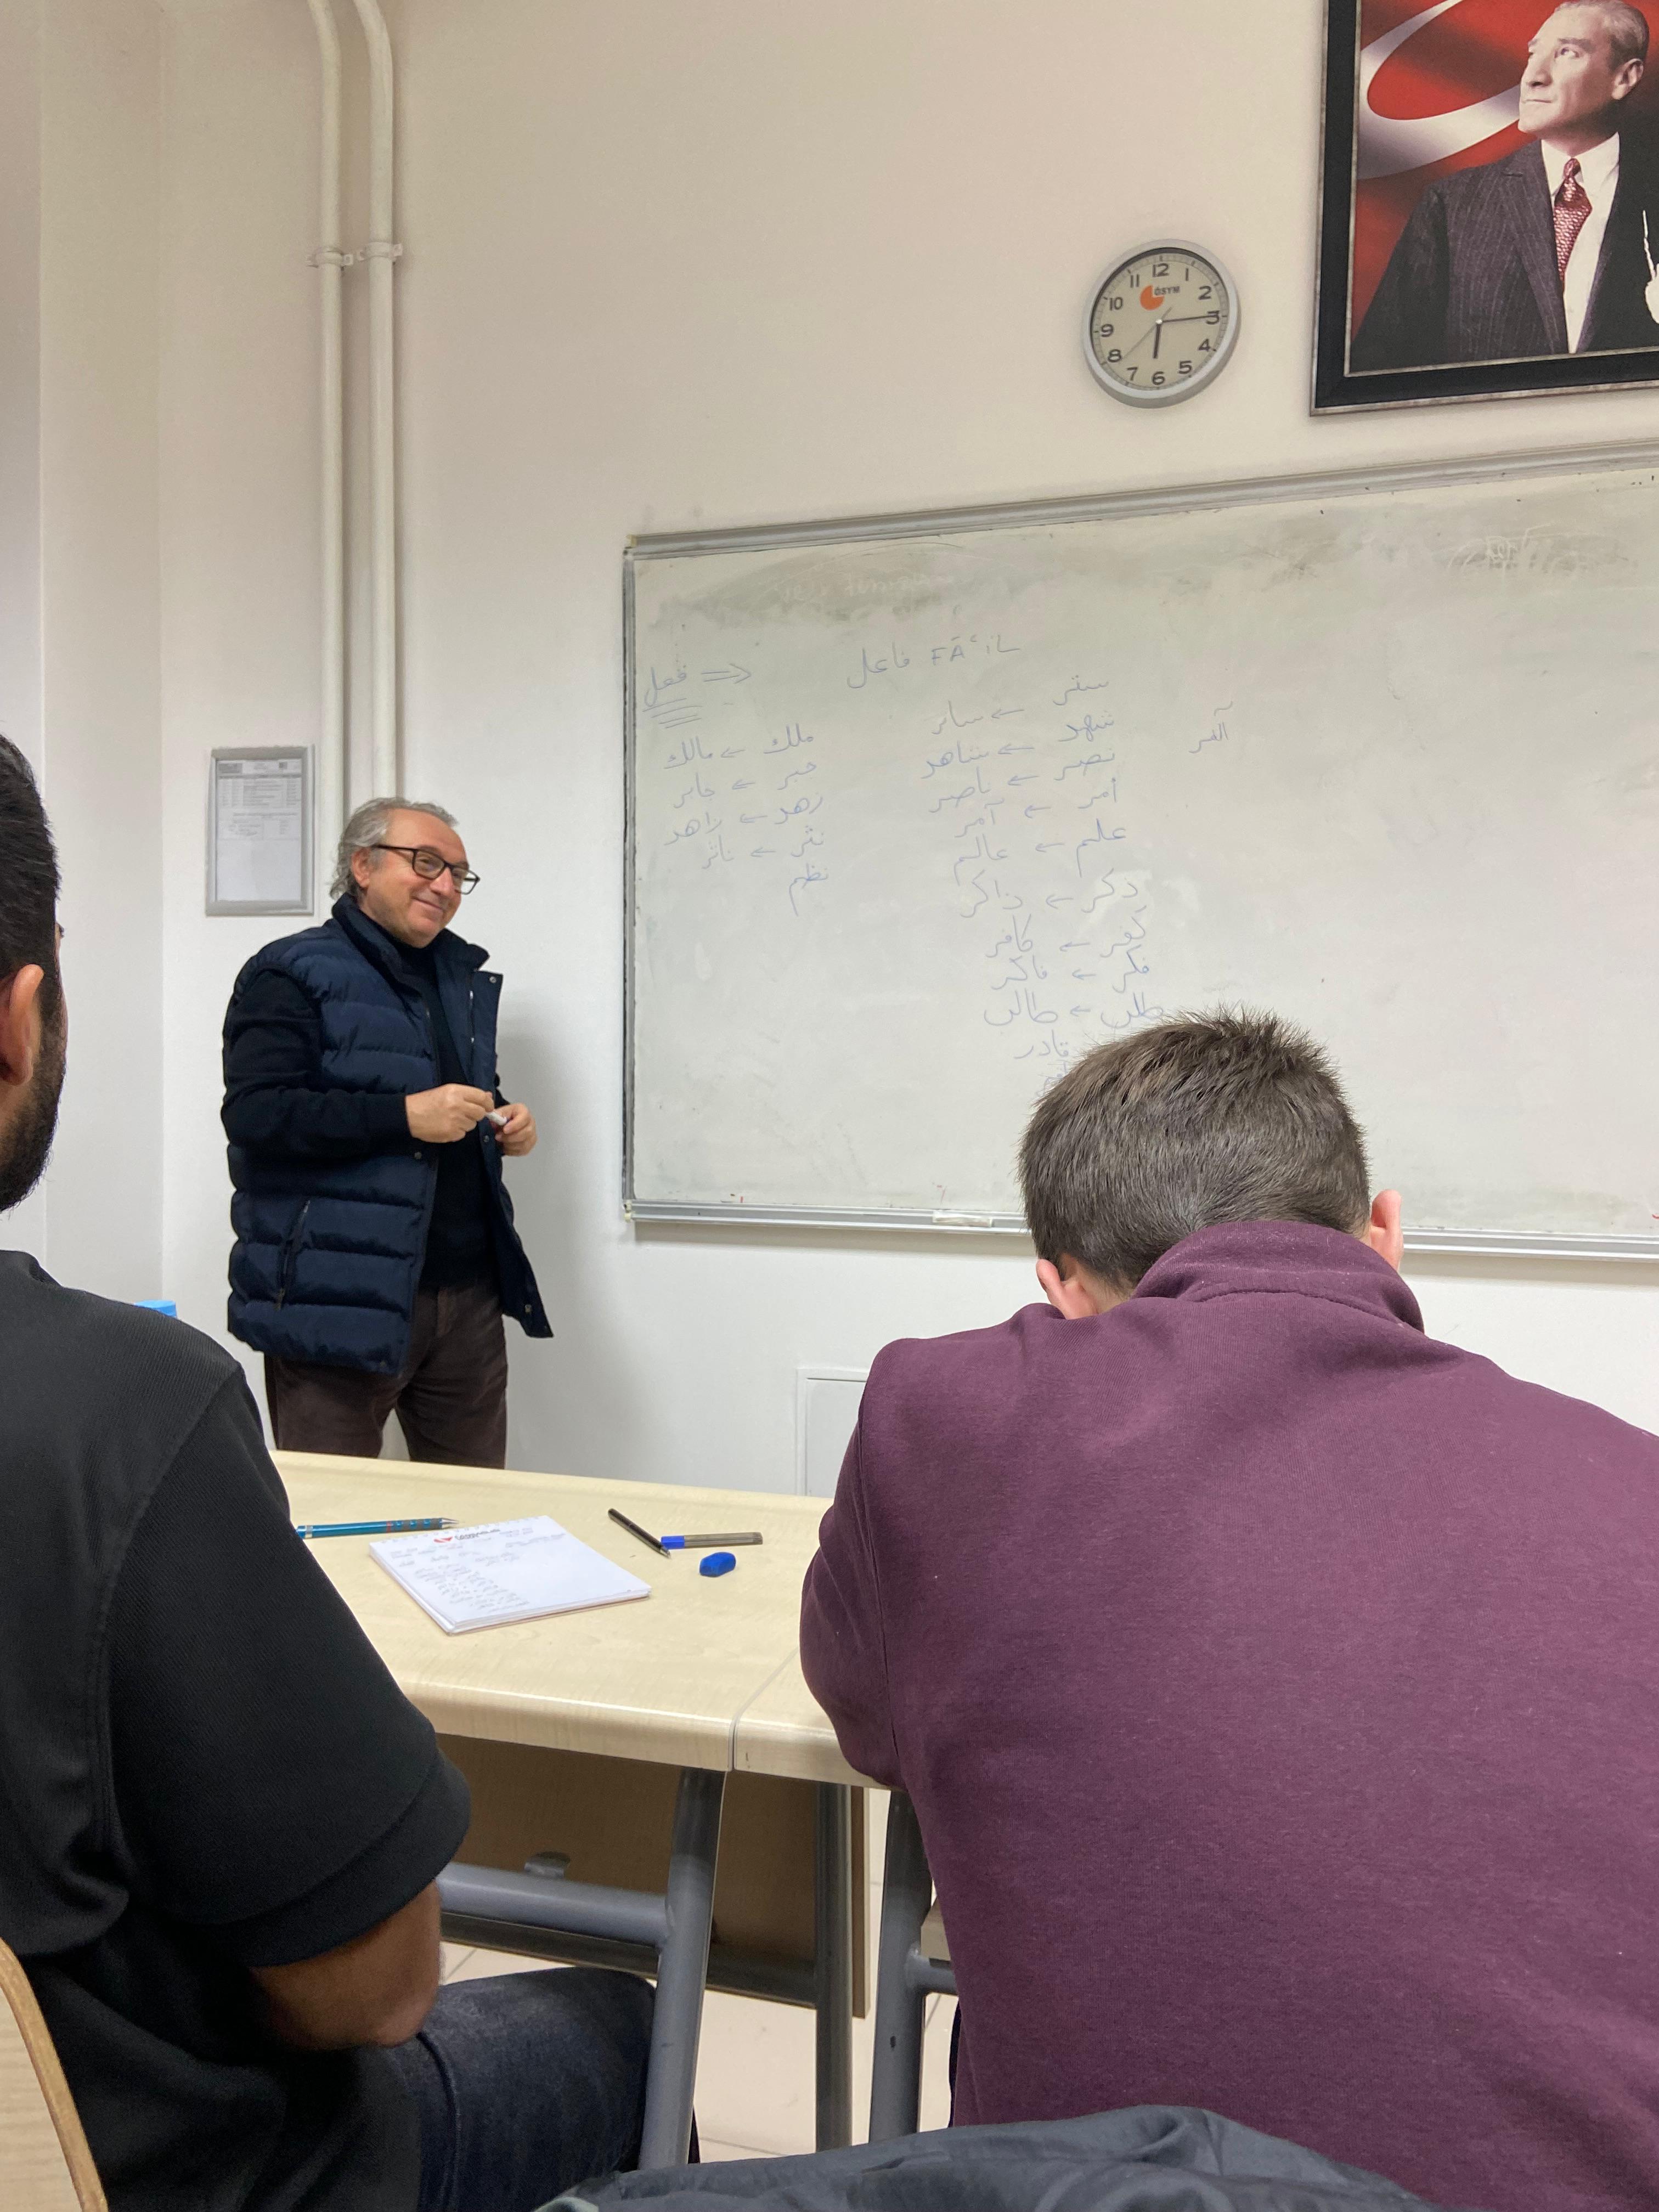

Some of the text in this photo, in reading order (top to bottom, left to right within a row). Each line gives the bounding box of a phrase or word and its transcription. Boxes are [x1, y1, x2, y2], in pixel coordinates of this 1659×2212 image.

[1152, 263, 1170, 277] 12
[1185, 268, 1189, 281] 1
[1130, 274, 1140, 288] 11
[1198, 285, 1212, 300] 2
[1109, 297, 1124, 311] 10
[1205, 310, 1220, 325] 3
[1101, 324, 1114, 337] 9
[1198, 339, 1211, 352] 4
[1107, 349, 1122, 363] 8
[1127, 366, 1138, 381] 7
[1178, 360, 1192, 374] 5
[1152, 371, 1165, 385] 6
[847, 641, 910, 689] فاعل
[663, 723, 814, 769] ملك مالك
